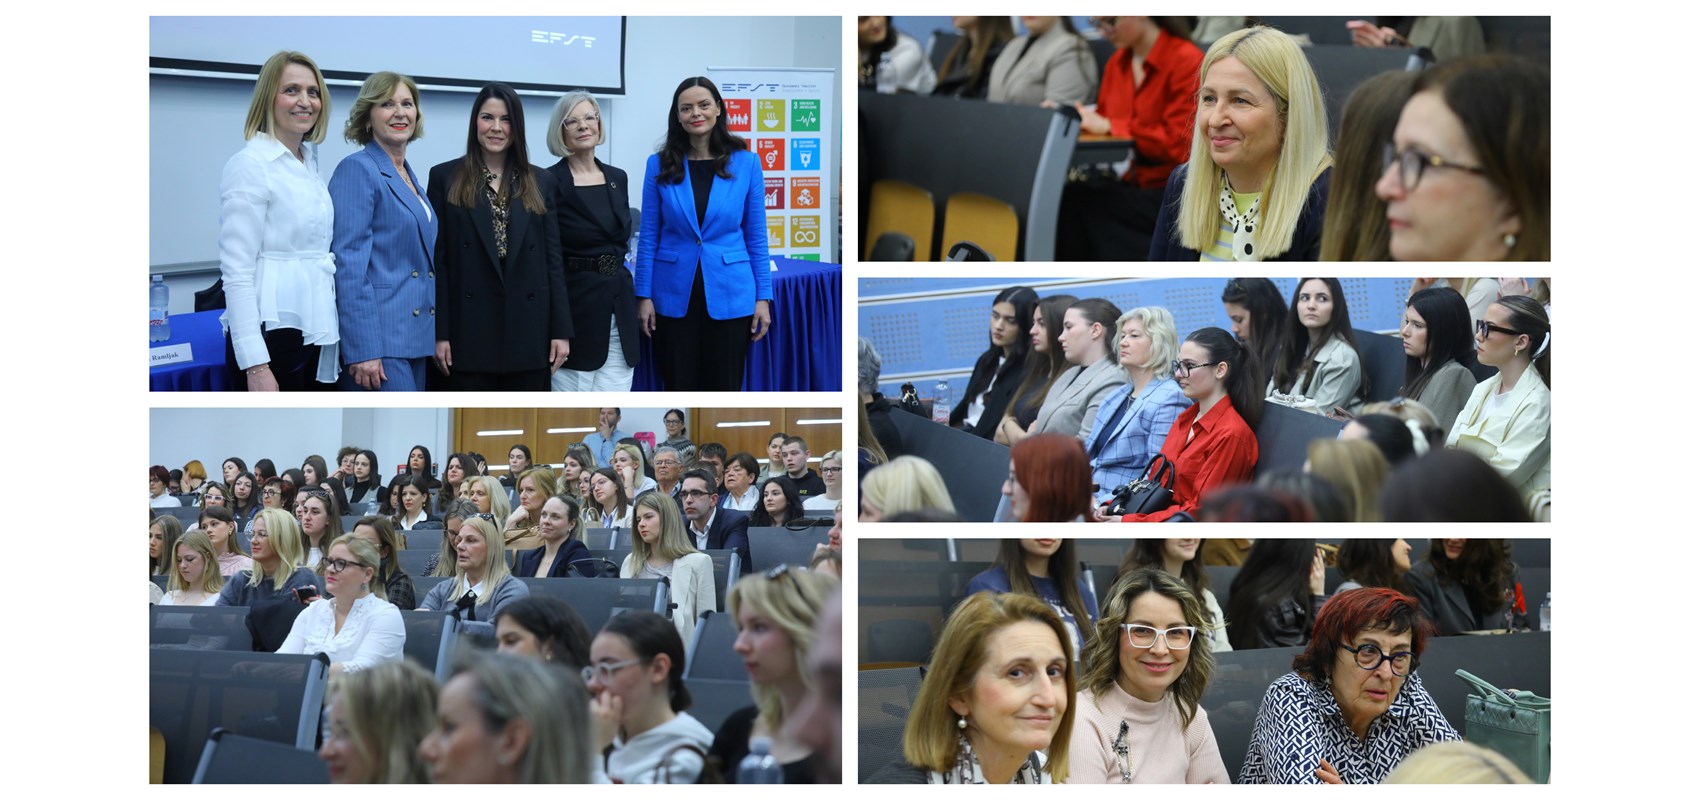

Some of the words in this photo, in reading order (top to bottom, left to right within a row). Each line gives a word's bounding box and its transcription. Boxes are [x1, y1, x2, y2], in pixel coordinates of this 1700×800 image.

[531, 30, 596, 48] EFST
[722, 83, 780, 92] EFST
[793, 101, 798, 109] 3
[759, 140, 763, 149] 5
[793, 140, 798, 149] 6
[792, 179, 797, 187] 9
[792, 217, 799, 226] 12
[152, 352, 178, 361] Ramljak
